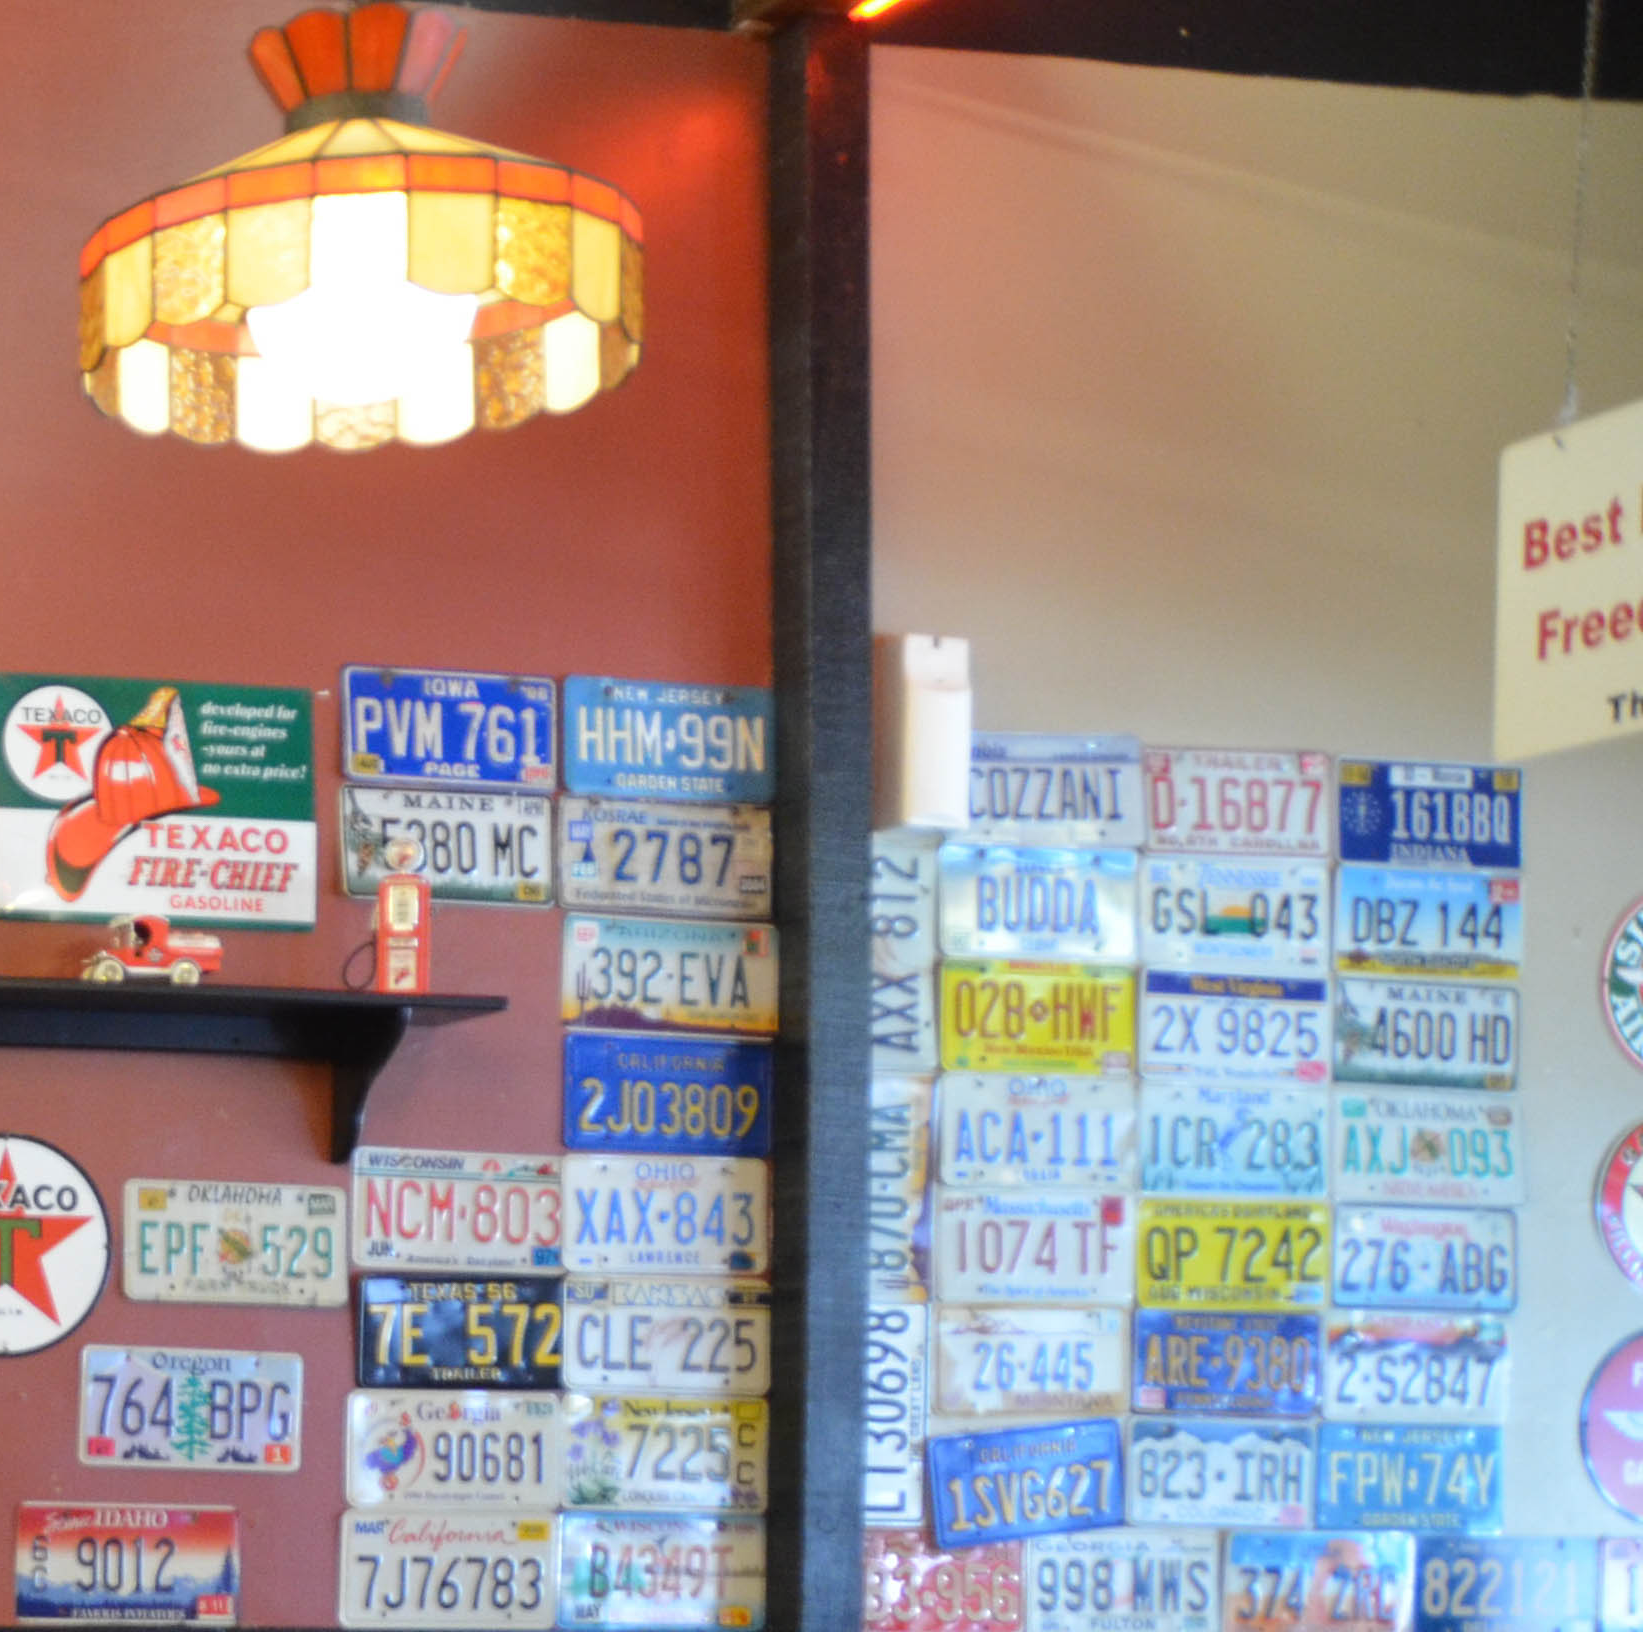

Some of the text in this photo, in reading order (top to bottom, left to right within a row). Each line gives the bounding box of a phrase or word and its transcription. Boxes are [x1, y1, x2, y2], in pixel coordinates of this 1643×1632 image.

[1522, 497, 1624, 571] Best
[424, 677, 479, 698] IOWA
[21, 706, 103, 723] TEXACO
[356, 697, 539, 764] PVM 761
[426, 763, 480, 779] PAGE
[403, 795, 495, 812] MAINE
[144, 823, 289, 854] TEXACO
[612, 829, 735, 887] 2787
[128, 856, 298, 892] FIRE-CHIEF
[170, 895, 264, 913] GASOLINE
[977, 875, 1100, 936] BUDDA
[1387, 987, 1466, 1002] MAINE
[1215, 1004, 1320, 1058] 9825
[1007, 1077, 1067, 1096] OHIO
[636, 1162, 696, 1181] OHIO
[188, 1184, 283, 1206] OKLAHOMA
[1146, 1226, 1322, 1283] QP 7242
[152, 1352, 232, 1377] Oregon
[432, 1367, 501, 1381] TRAILER
[434, 1431, 544, 1483] 90681
[76, 1537, 177, 1594] 9012
[357, 1555, 543, 1610] 7J76783
